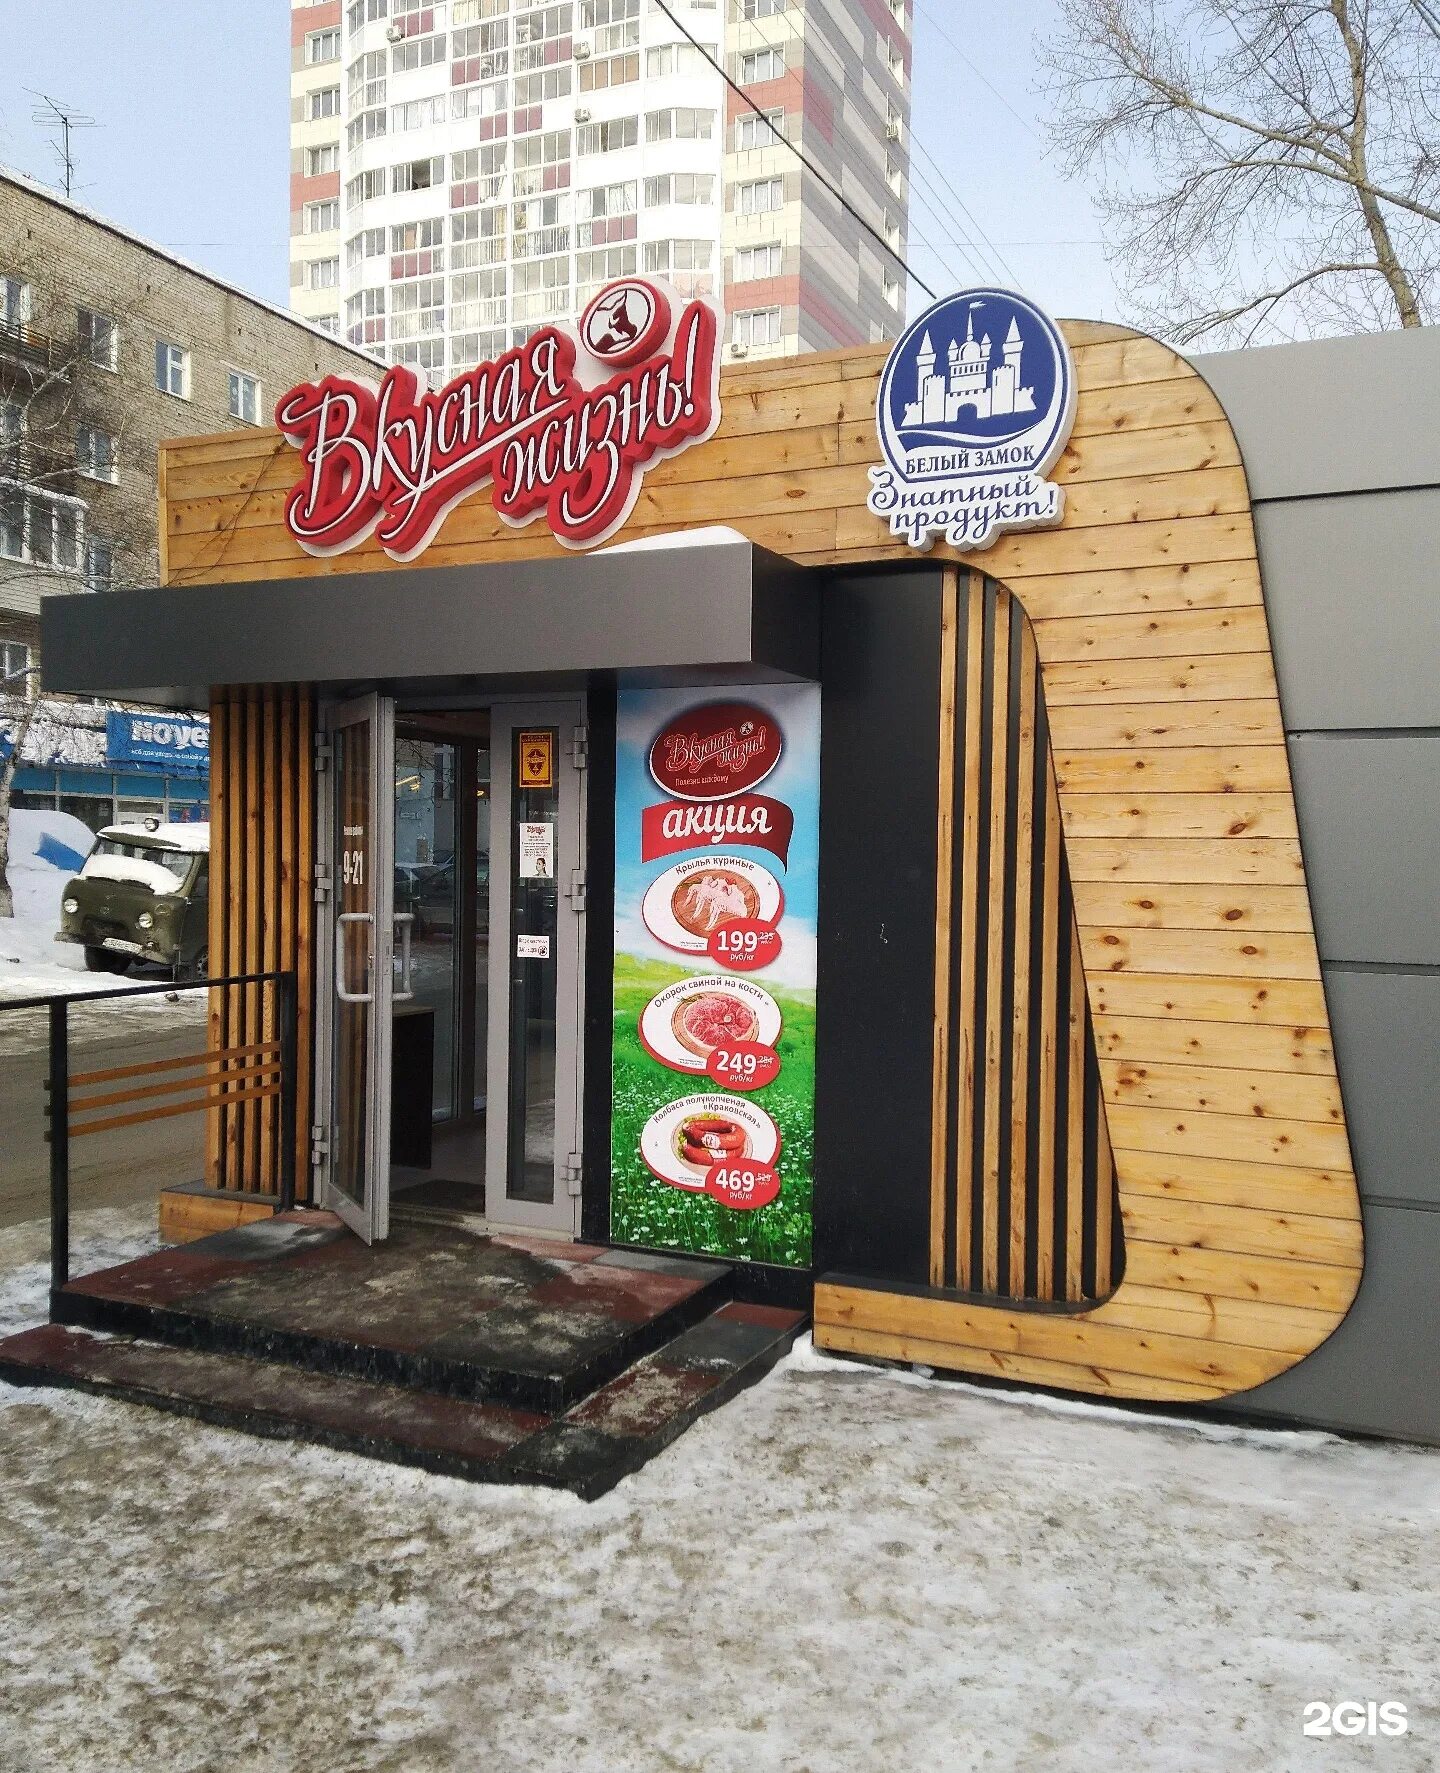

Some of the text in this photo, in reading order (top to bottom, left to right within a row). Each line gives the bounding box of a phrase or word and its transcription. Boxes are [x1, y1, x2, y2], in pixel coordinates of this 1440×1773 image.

[503, 311, 700, 525] жизнь!
[282, 337, 568, 540] Вкусная
[906, 445, 1035, 475] БЕЛЫЙ ЗАМОК
[872, 474, 1038, 510] Знатный
[895, 490, 1056, 542] продукт!
[666, 731, 736, 772] Вкусная
[662, 804, 773, 844] акция
[343, 850, 363, 885] 9-21
[675, 857, 755, 875] Крылья куриные
[717, 930, 758, 953] 199
[730, 952, 754, 962] руб/кг
[654, 976, 764, 1008] Окорок свиной на кости
[716, 1050, 757, 1075] 249
[729, 1073, 753, 1083] руб/кг
[652, 1095, 746, 1124] Колбаса полукопченая
[715, 1168, 755, 1192] 469
[729, 1191, 752, 1200] руб/кг
